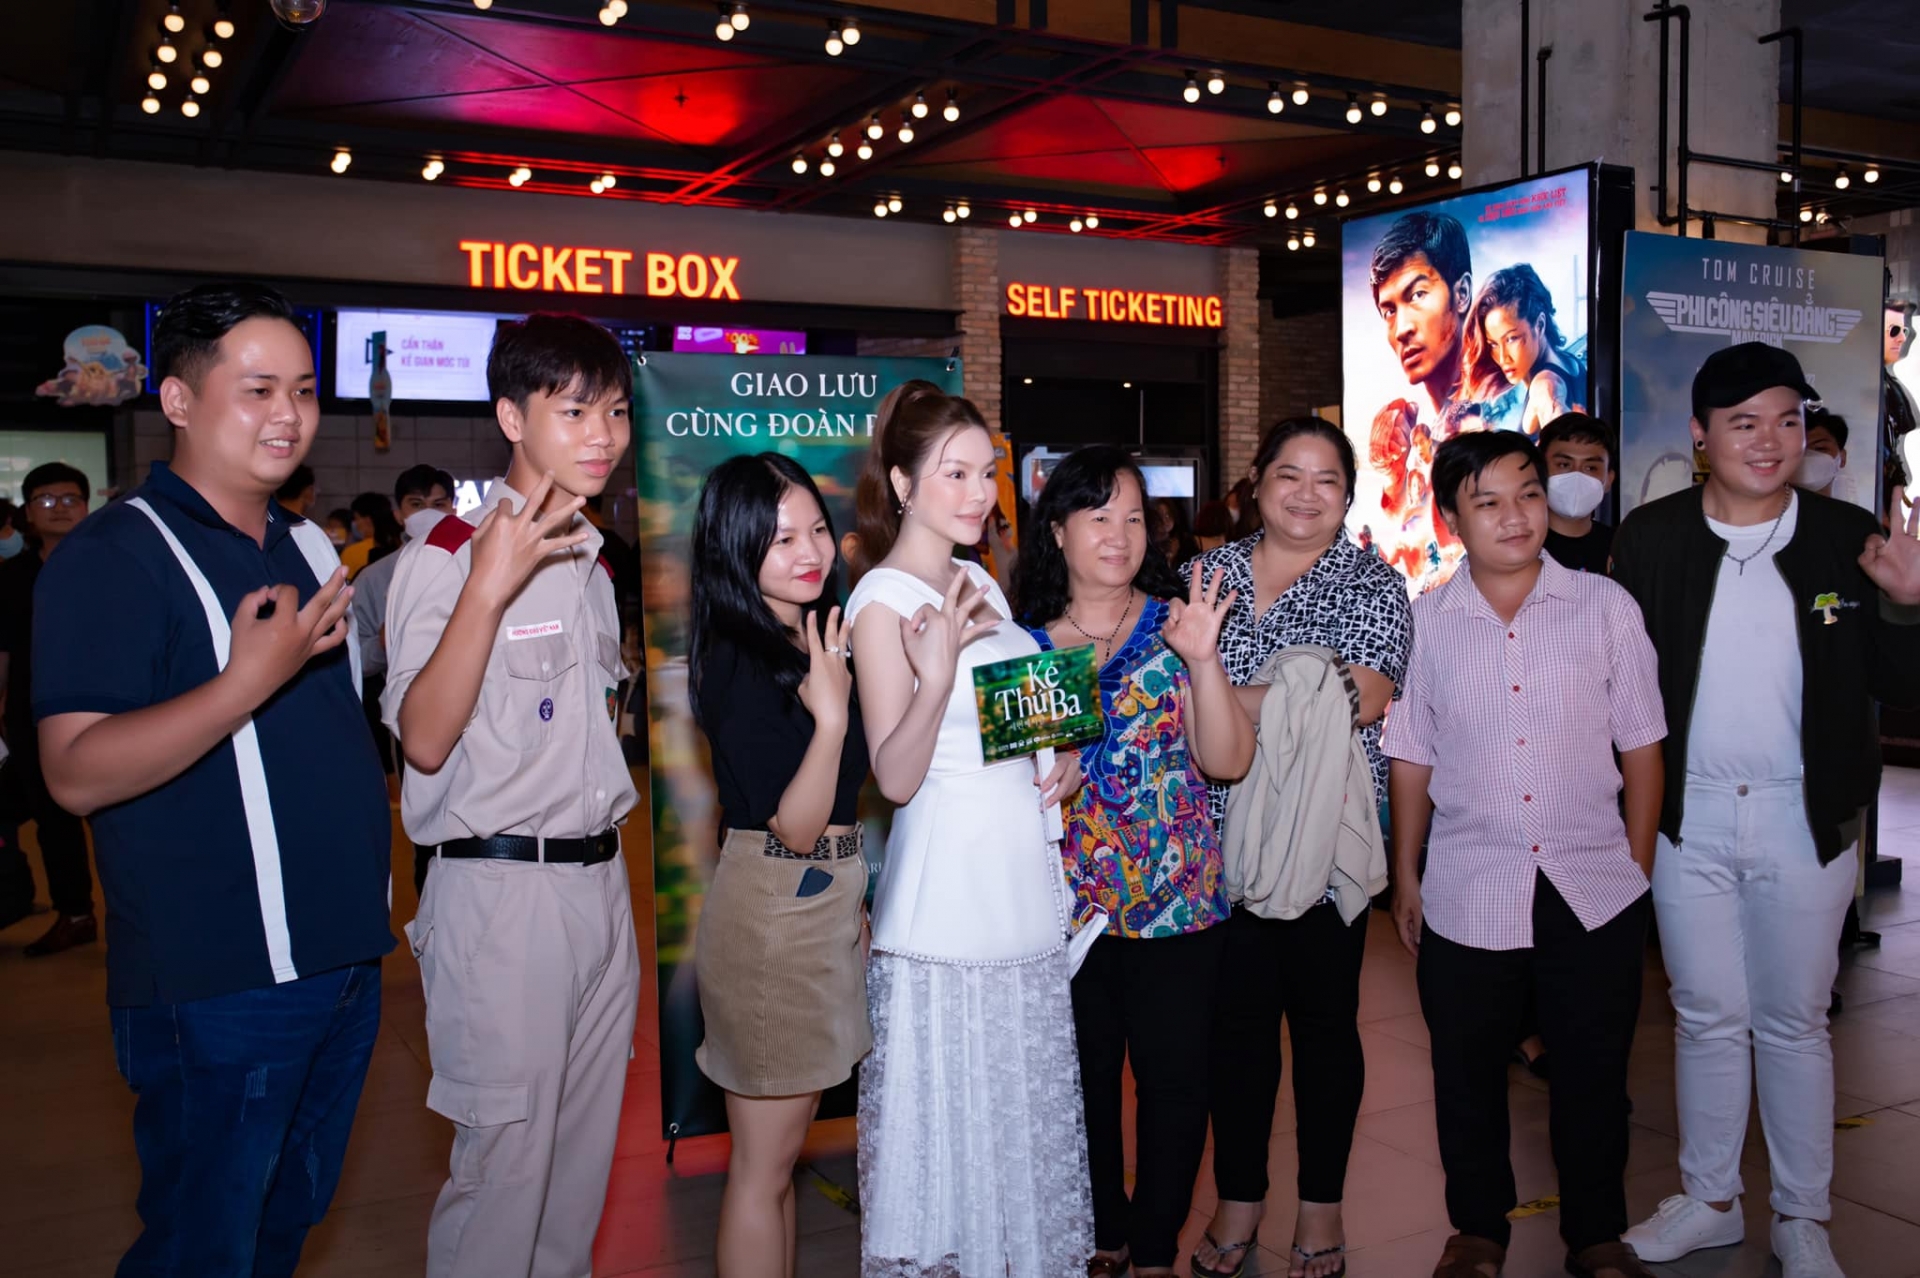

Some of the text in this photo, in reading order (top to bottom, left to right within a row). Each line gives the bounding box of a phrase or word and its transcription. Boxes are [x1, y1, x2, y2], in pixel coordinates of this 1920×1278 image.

[459, 240, 741, 301] TICKET BOX
[1702, 257, 1816, 290] TOM CRUISE
[1006, 281, 1223, 328] SELF TICKETING
[1676, 291, 1836, 337] PHI CÔNG SIÊU ĐẲNG
[731, 371, 877, 398] GIAO LƯU
[666, 407, 758, 437] CÙNG
[767, 408, 854, 437] ĐOÀN
[1048, 688, 1083, 721] Ba
